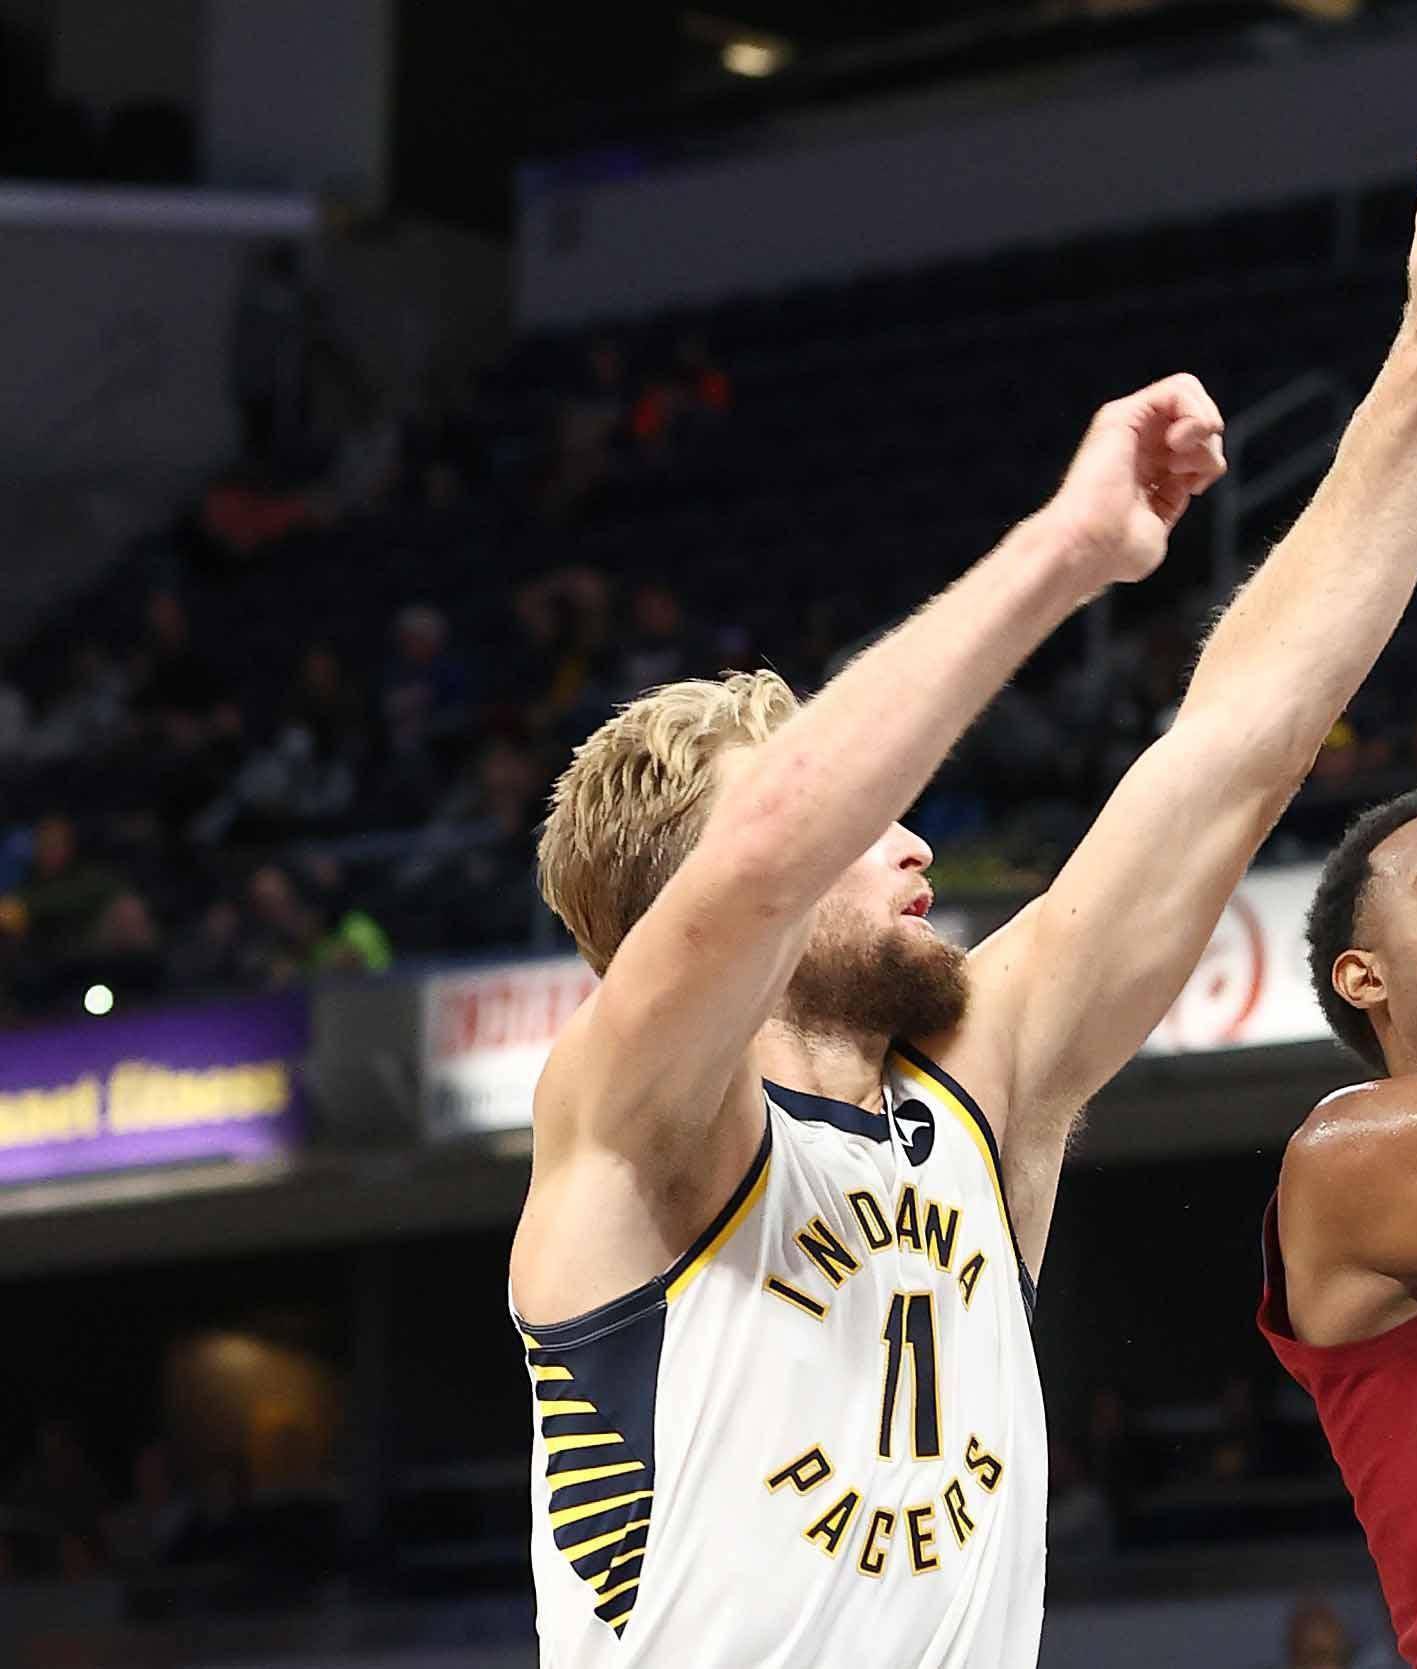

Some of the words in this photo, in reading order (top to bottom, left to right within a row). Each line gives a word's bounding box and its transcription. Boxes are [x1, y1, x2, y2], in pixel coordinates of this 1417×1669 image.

[763, 1184, 988, 1322] INDANA
[880, 1290, 943, 1461] 11
[763, 1434, 1004, 1578] PACERS
